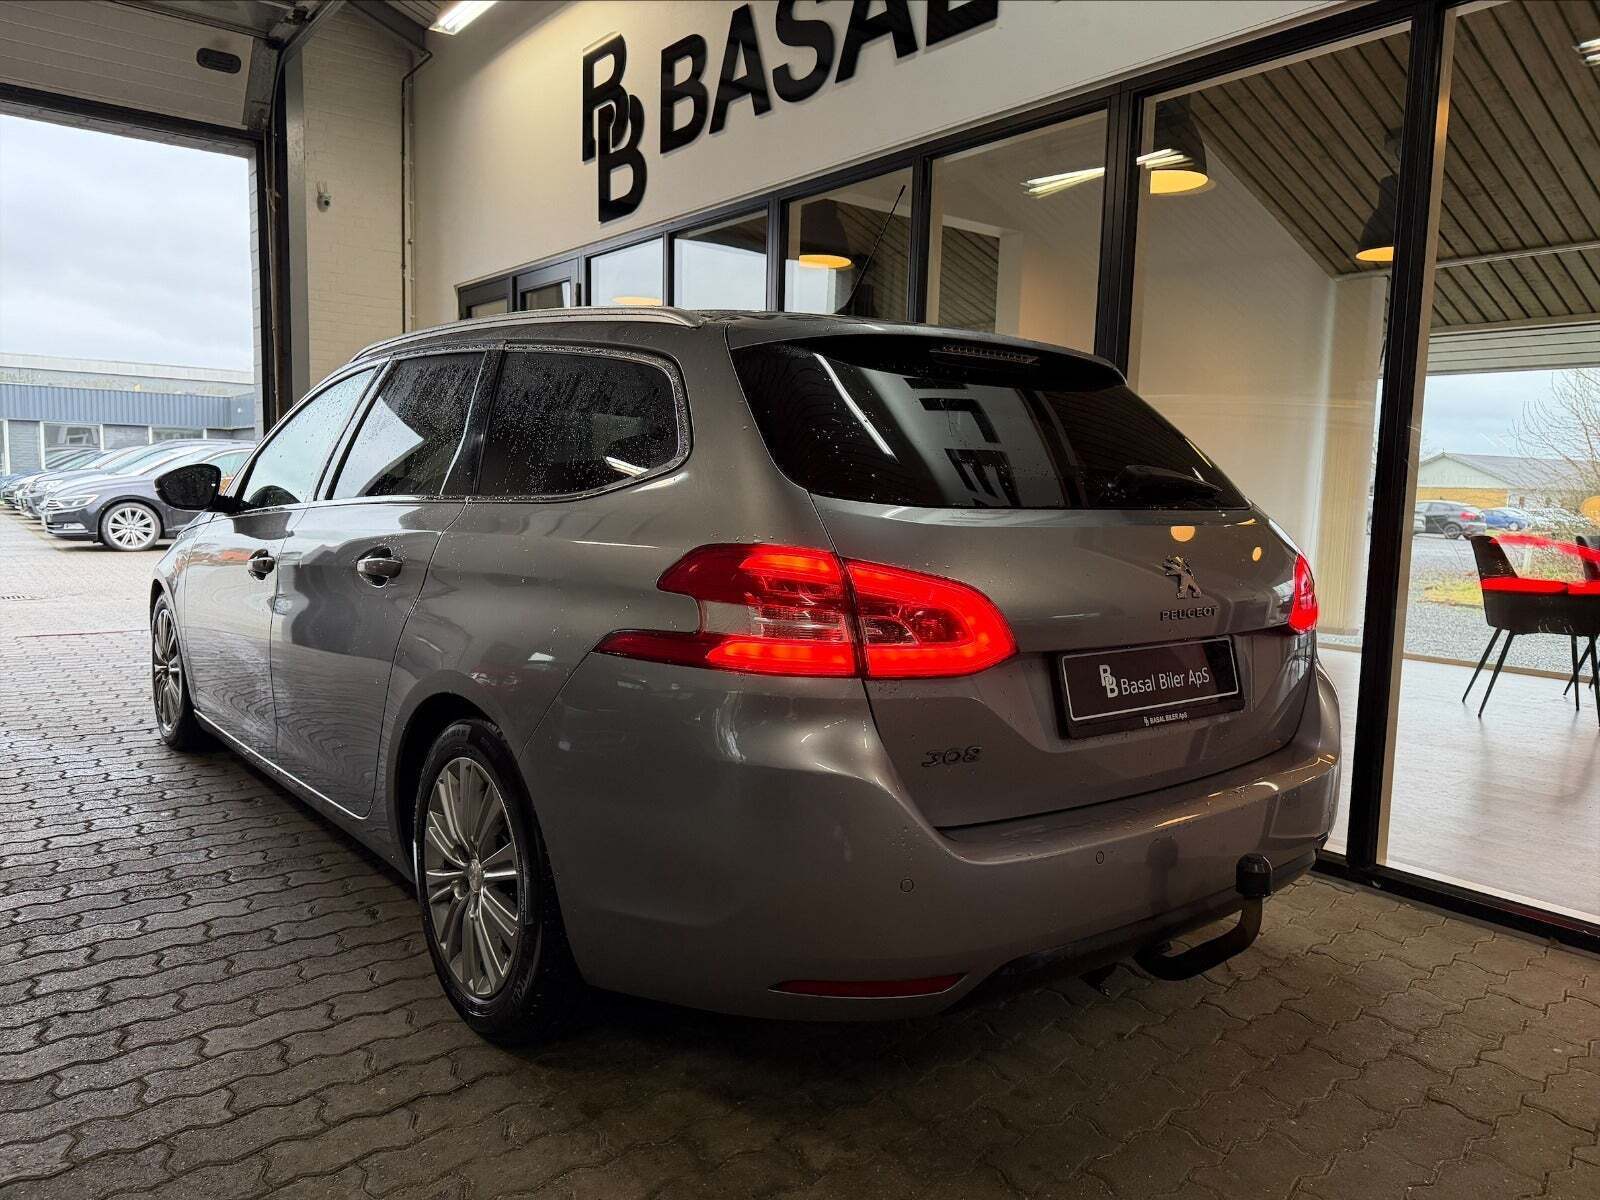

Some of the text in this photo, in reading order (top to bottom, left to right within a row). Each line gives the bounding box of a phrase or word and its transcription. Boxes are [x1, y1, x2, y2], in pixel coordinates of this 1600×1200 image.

[1160, 605, 1218, 621] PEUGEOT
[1120, 674, 1156, 696] Basal
[1159, 672, 1185, 690] Biler
[1188, 667, 1210, 688] ApS
[1149, 715, 1165, 725] BASAL
[1178, 711, 1188, 720] ApS
[922, 746, 982, 768] 308
